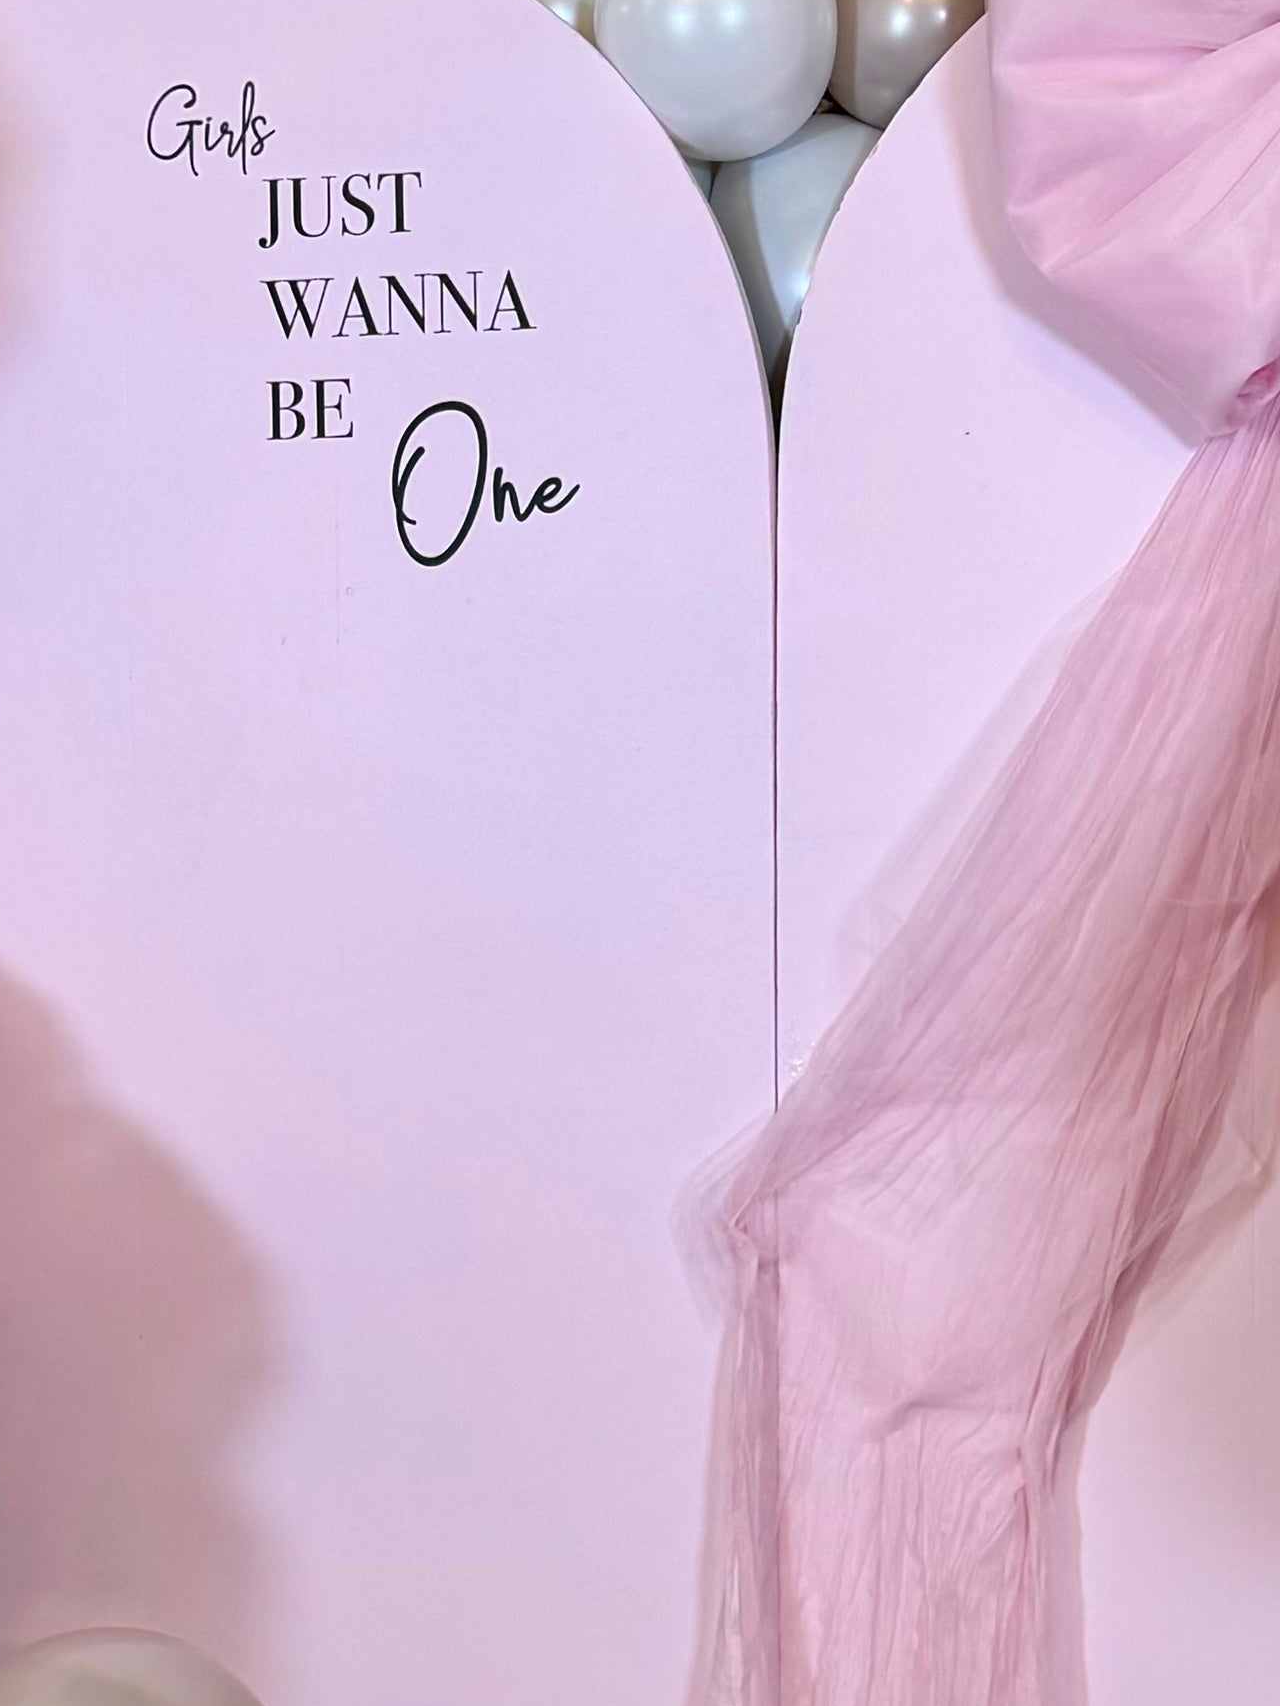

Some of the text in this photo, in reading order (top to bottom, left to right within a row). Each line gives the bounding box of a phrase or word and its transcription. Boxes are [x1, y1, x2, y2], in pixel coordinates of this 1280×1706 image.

[146, 80, 276, 177] Girls
[258, 171, 423, 249] JUST
[260, 269, 538, 340] WANNA
[266, 378, 355, 441] BE
[391, 400, 581, 567] One
